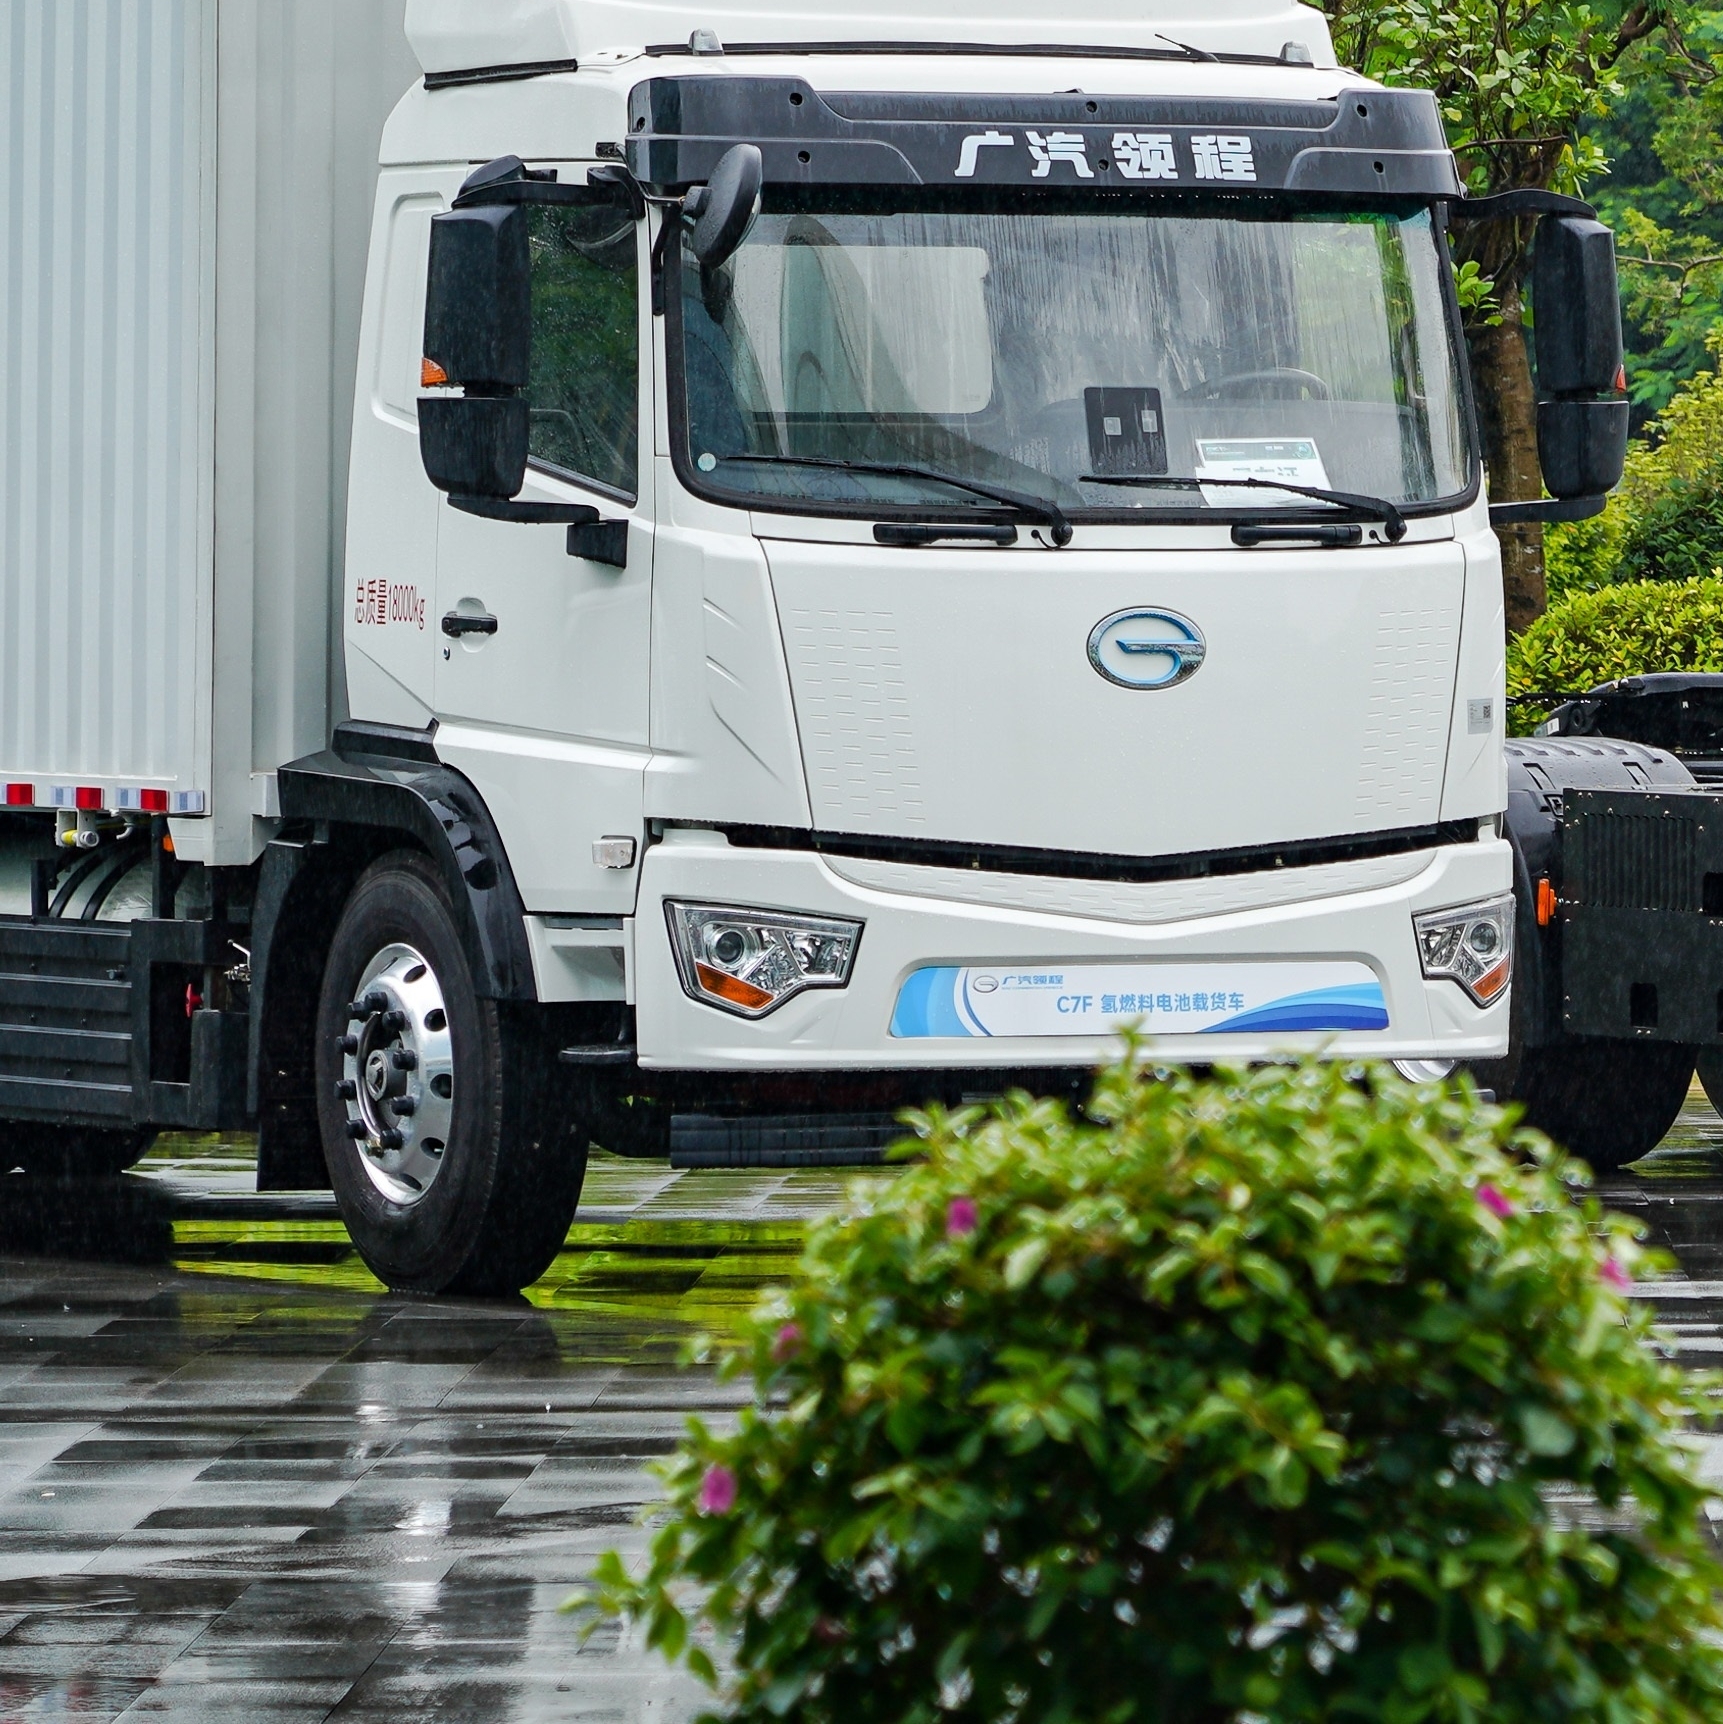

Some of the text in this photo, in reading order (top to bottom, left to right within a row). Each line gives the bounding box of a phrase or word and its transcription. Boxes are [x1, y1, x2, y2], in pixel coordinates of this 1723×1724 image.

[954, 131, 1257, 181] 广汽领程
[354, 578, 425, 630] 总质量18000kg
[1056, 992, 1245, 1014] C7F 氢燃料电池载货车
